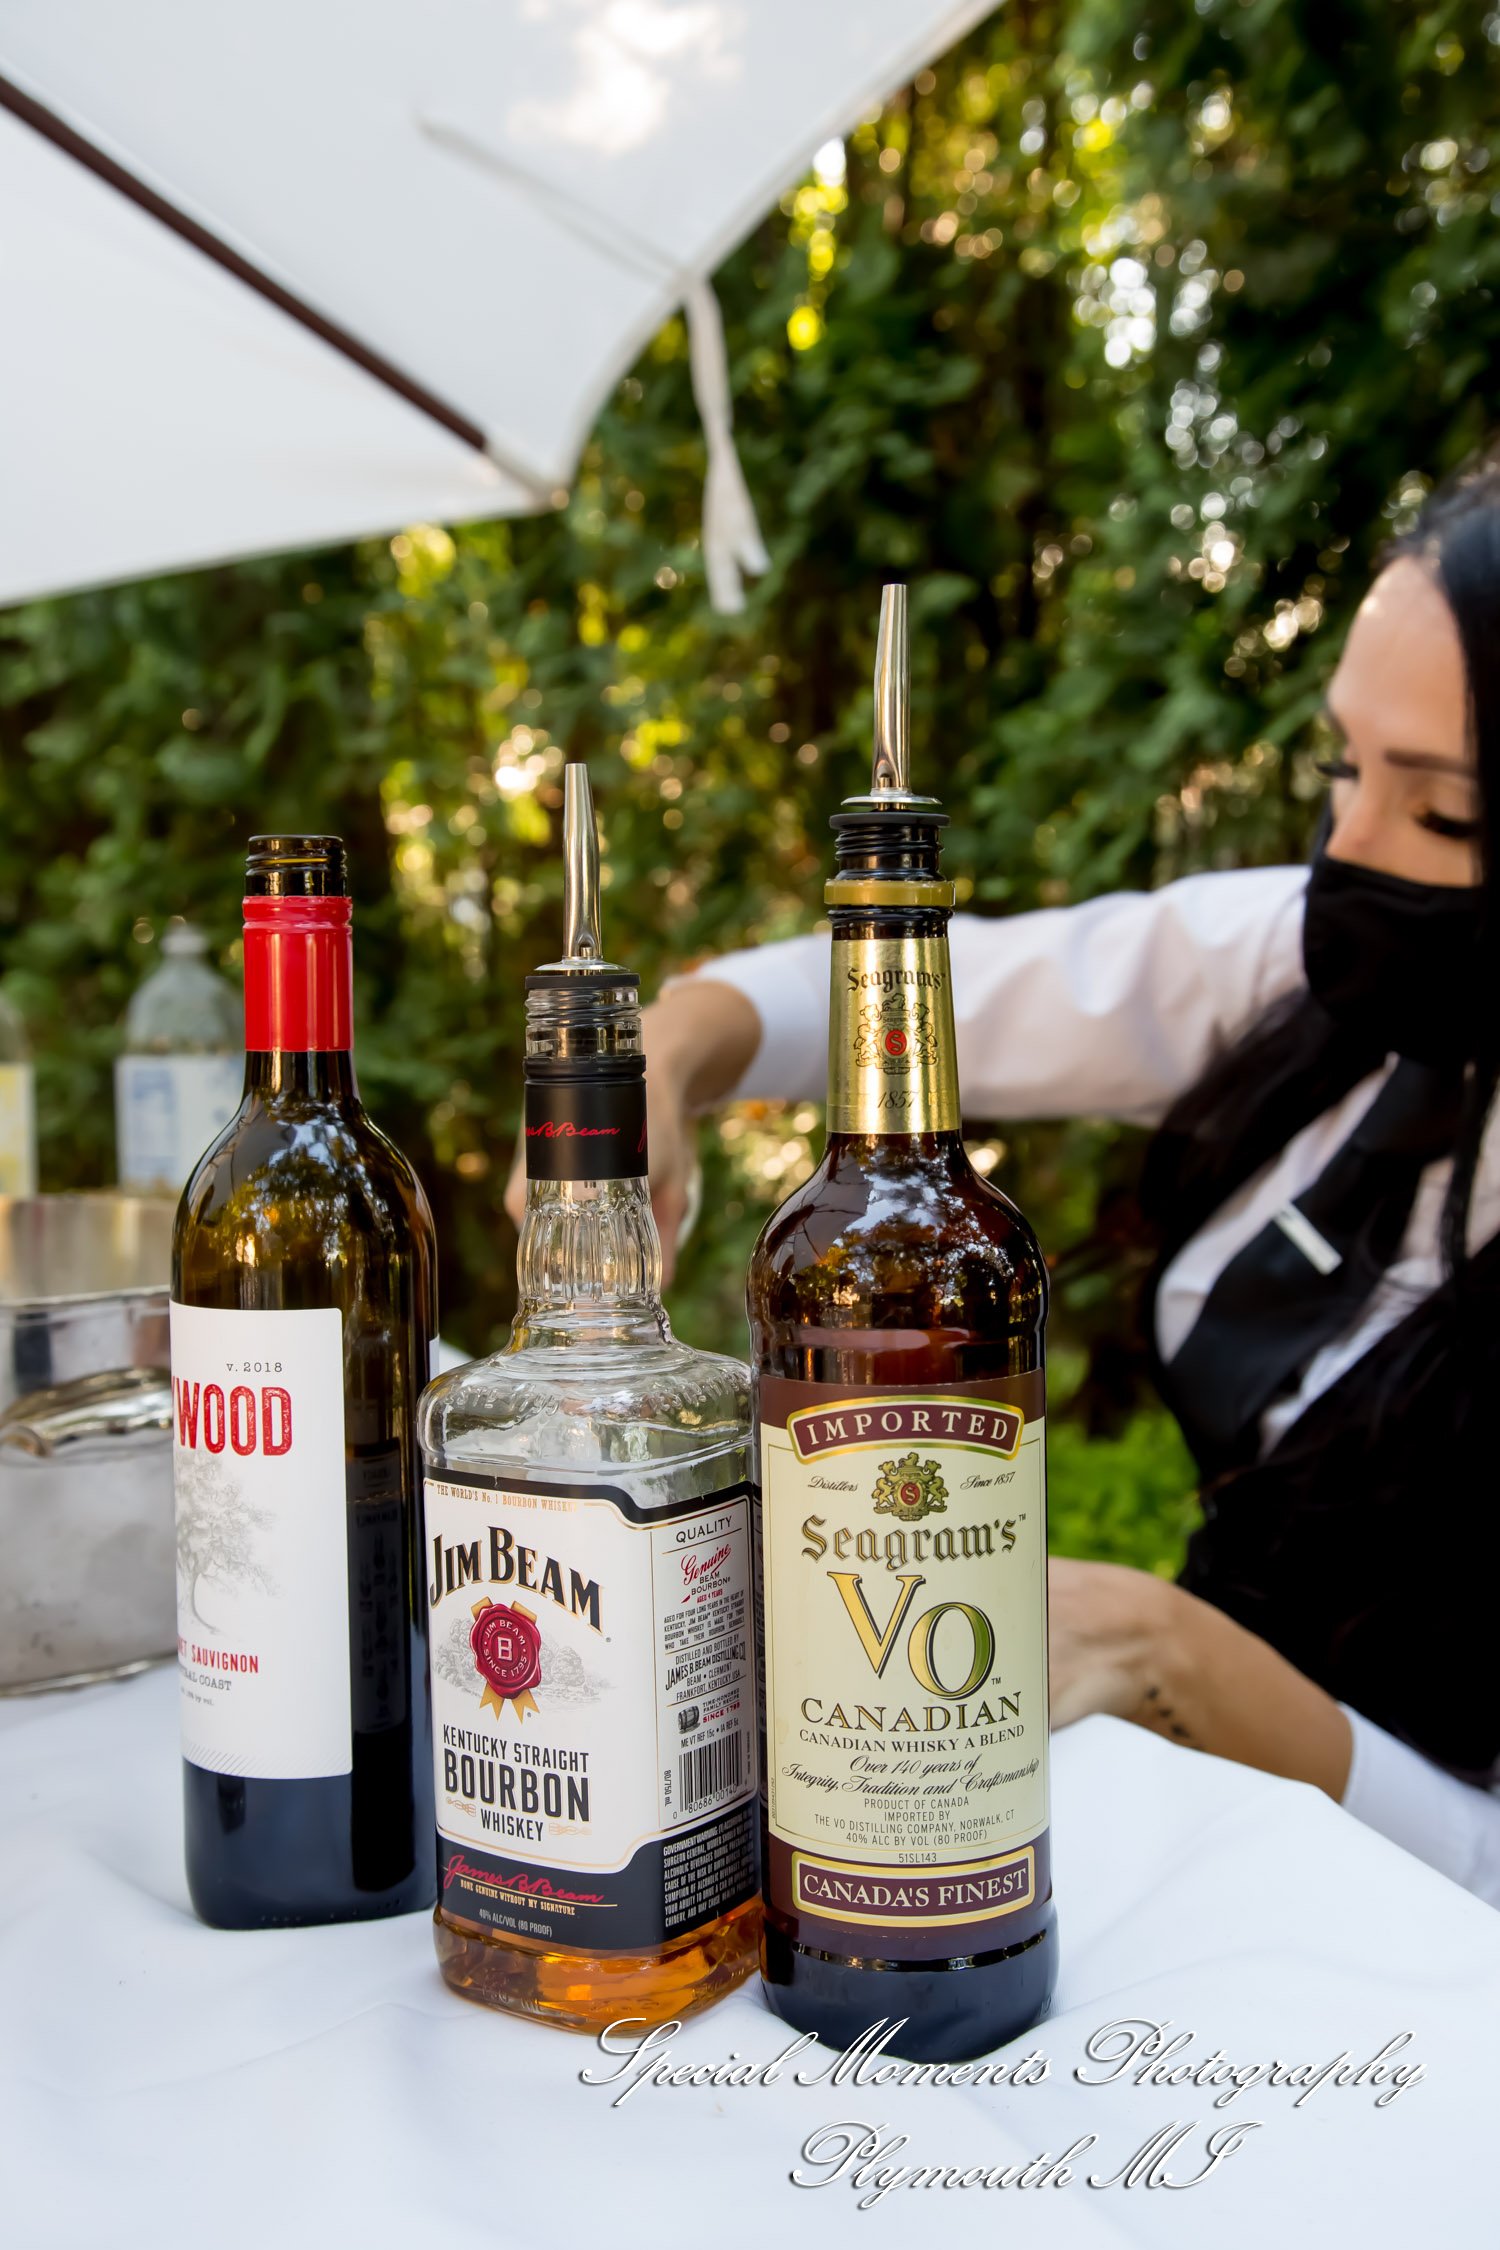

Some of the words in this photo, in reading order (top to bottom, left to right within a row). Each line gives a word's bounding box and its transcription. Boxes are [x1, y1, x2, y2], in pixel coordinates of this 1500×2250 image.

[877, 1090, 920, 1109] 1857
[556, 1121, 620, 1137] Beam
[172, 1376, 293, 1456] WOOD
[806, 1410, 1008, 1445] IMPORTED
[807, 1475, 859, 1492] Distillers
[960, 1474, 992, 1490] Since
[993, 1471, 1016, 1486] 1857
[437, 1485, 449, 1496] THE
[450, 1486, 479, 1501] WORLD'S
[481, 1492, 493, 1503] No.
[502, 1495, 538, 1509] BOURBON
[540, 1499, 578, 1513] WHISKEY
[676, 1516, 732, 1543] QUALITY
[801, 1514, 1017, 1571] Seagram's
[680, 1544, 731, 1586] Genuine
[699, 1571, 720, 1584] BEAM
[429, 1533, 484, 1609] JIM
[487, 1525, 605, 1636] BEAM
[484, 1622, 497, 1638] JIM
[500, 1619, 526, 1645] BEAM
[826, 1571, 996, 1701] VO
[192, 1644, 259, 1673] SAUVIGNON
[497, 1636, 513, 1661] B
[676, 1649, 700, 1665] DISTILLED
[702, 1644, 713, 1656] AND
[714, 1636, 733, 1652] BOTTLED
[483, 1648, 507, 1677] SINCE
[510, 1655, 527, 1677] 1795
[665, 1664, 689, 1691] JAMES
[695, 1655, 711, 1672] BEAM
[687, 1674, 702, 1687] BEAM
[708, 1662, 732, 1679] CLERMONT
[199, 1674, 232, 1691] COAST
[708, 1674, 731, 1690] KENTUCKY
[702, 1709, 724, 1724] SINCE
[703, 1702, 722, 1713] FAMILY
[800, 1691, 1022, 1733] CANADIAN
[443, 1723, 508, 1760] KENTUCKY
[513, 1742, 590, 1773] STRAIGHT
[800, 1729, 886, 1753] CANADIAN
[891, 1739, 959, 1753] WHISKY
[964, 1737, 975, 1749] A
[980, 1724, 1024, 1746] BLEND
[782, 1763, 840, 1793] Integrity,
[841, 1775, 917, 1796] Tradition
[923, 1778, 960, 1795] and
[960, 1757, 1039, 1792] Craftsmanship
[849, 1755, 887, 1774] Over
[890, 1759, 921, 1774] 140
[921, 1758, 961, 1779] years
[964, 1753, 983, 1774] of
[444, 1747, 592, 1824] BOURBON
[688, 1796, 713, 1813] 80686
[864, 1798, 910, 1810] PRODUCT
[915, 1799, 926, 1809] OF
[930, 1796, 969, 1809] CANADA
[884, 1811, 930, 1822] IMPORTED
[937, 1811, 950, 1821] BY
[480, 1808, 544, 1842] WHISKEY
[814, 1814, 831, 1827] THE
[833, 1819, 845, 1830] VO
[849, 1821, 903, 1834] DISTILLING
[907, 1822, 956, 1834] COMPANY,
[959, 1814, 1004, 1830] NORWALK,
[1006, 1810, 1014, 1820] CT
[846, 1833, 868, 1844] 40%
[872, 1835, 890, 1846] ALC
[894, 1835, 906, 1846] BY
[910, 1835, 929, 1846] VOL
[933, 1834, 950, 1846] (80
[953, 1830, 987, 1844] PROOF)
[898, 1853, 937, 1863] 51SL143
[443, 1854, 502, 1889] James
[531, 1878, 604, 1903] Beam
[803, 1874, 929, 1908] CANADA'S
[938, 1868, 1026, 1906] FINEST
[460, 1879, 474, 1892] NONE
[475, 1884, 498, 1899] GENUINE
[499, 1891, 526, 1907] WITHOUT
[528, 1898, 538, 1909] MY
[540, 1901, 576, 1916] SIGNATURE
[492, 1912, 517, 1929] ALC/VOL
[517, 1919, 529, 1931] (80
[529, 1921, 553, 1938] PROOF)
